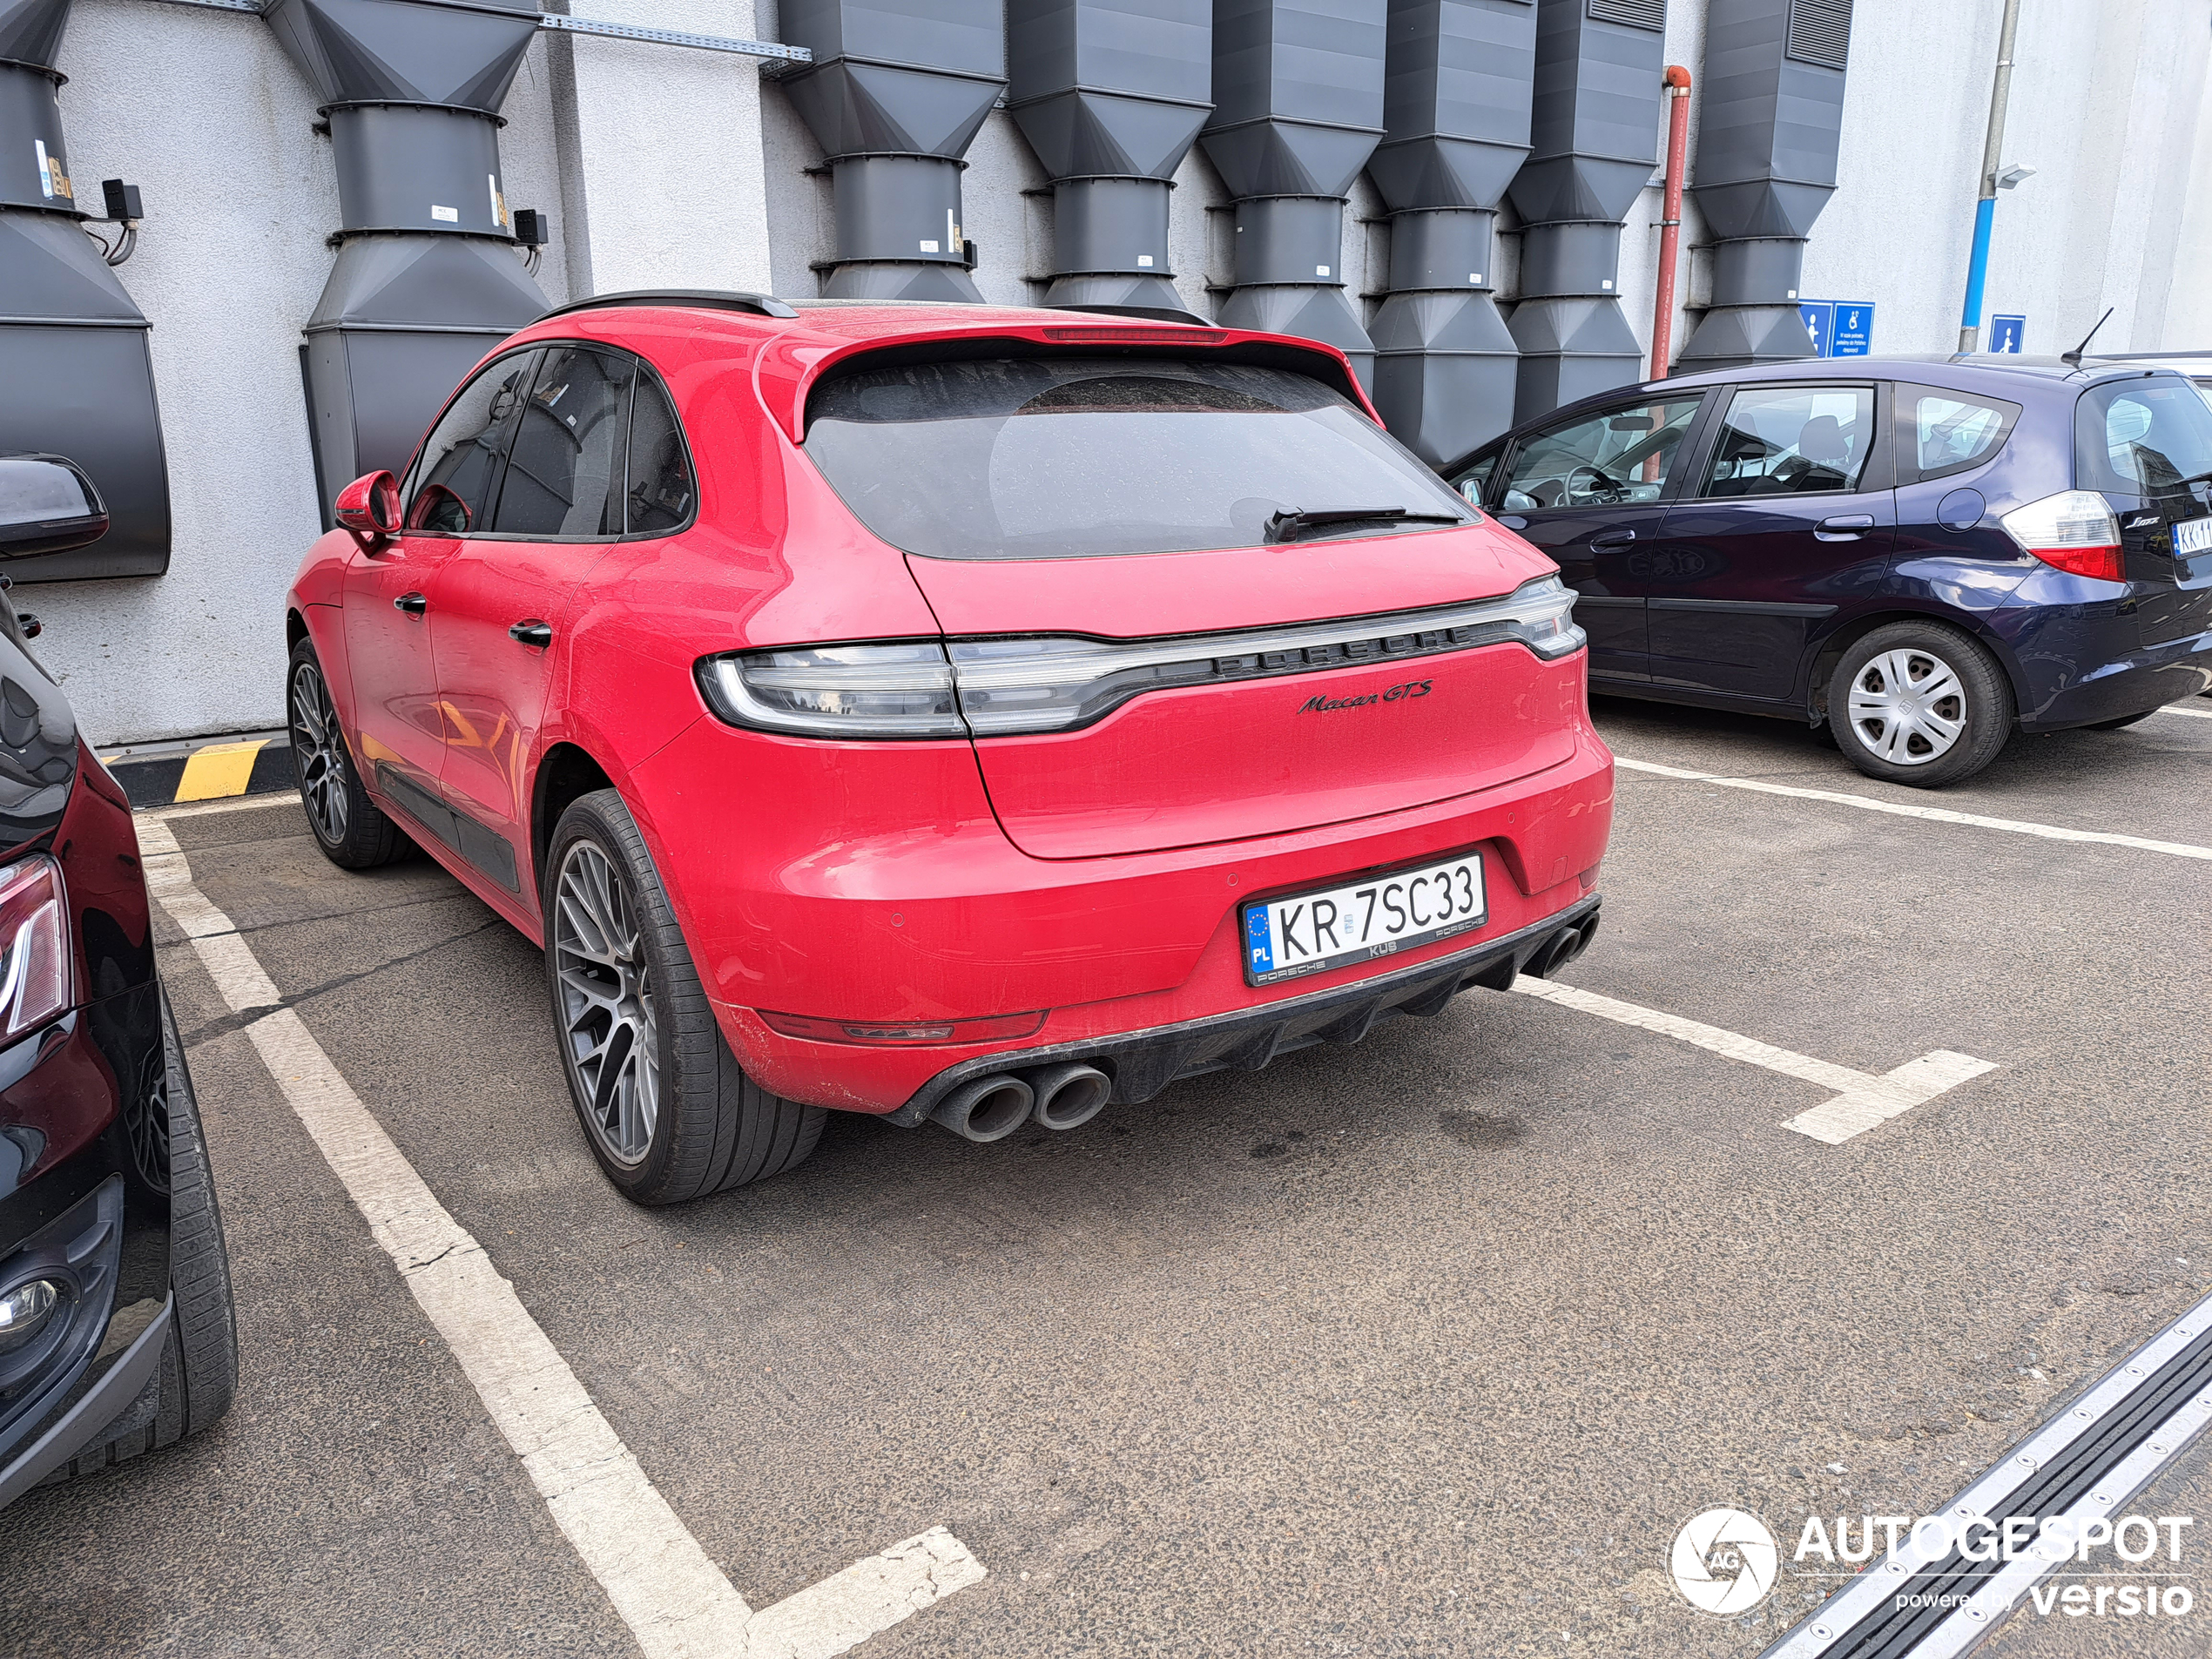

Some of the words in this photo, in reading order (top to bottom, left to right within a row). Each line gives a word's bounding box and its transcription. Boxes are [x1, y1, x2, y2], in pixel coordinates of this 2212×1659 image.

[2180, 523, 2197, 550] KK
[1216, 627, 1469, 675] PORSCHE
[1297, 692, 1379, 714] Macan
[1383, 679, 1433, 701] GTS
[1279, 899, 1341, 961] KR
[1355, 866, 1474, 941] 7SC33
[1435, 916, 1486, 938] PORSCHE
[1252, 948, 1271, 963] PL
[1257, 961, 1326, 983] PORSCHE
